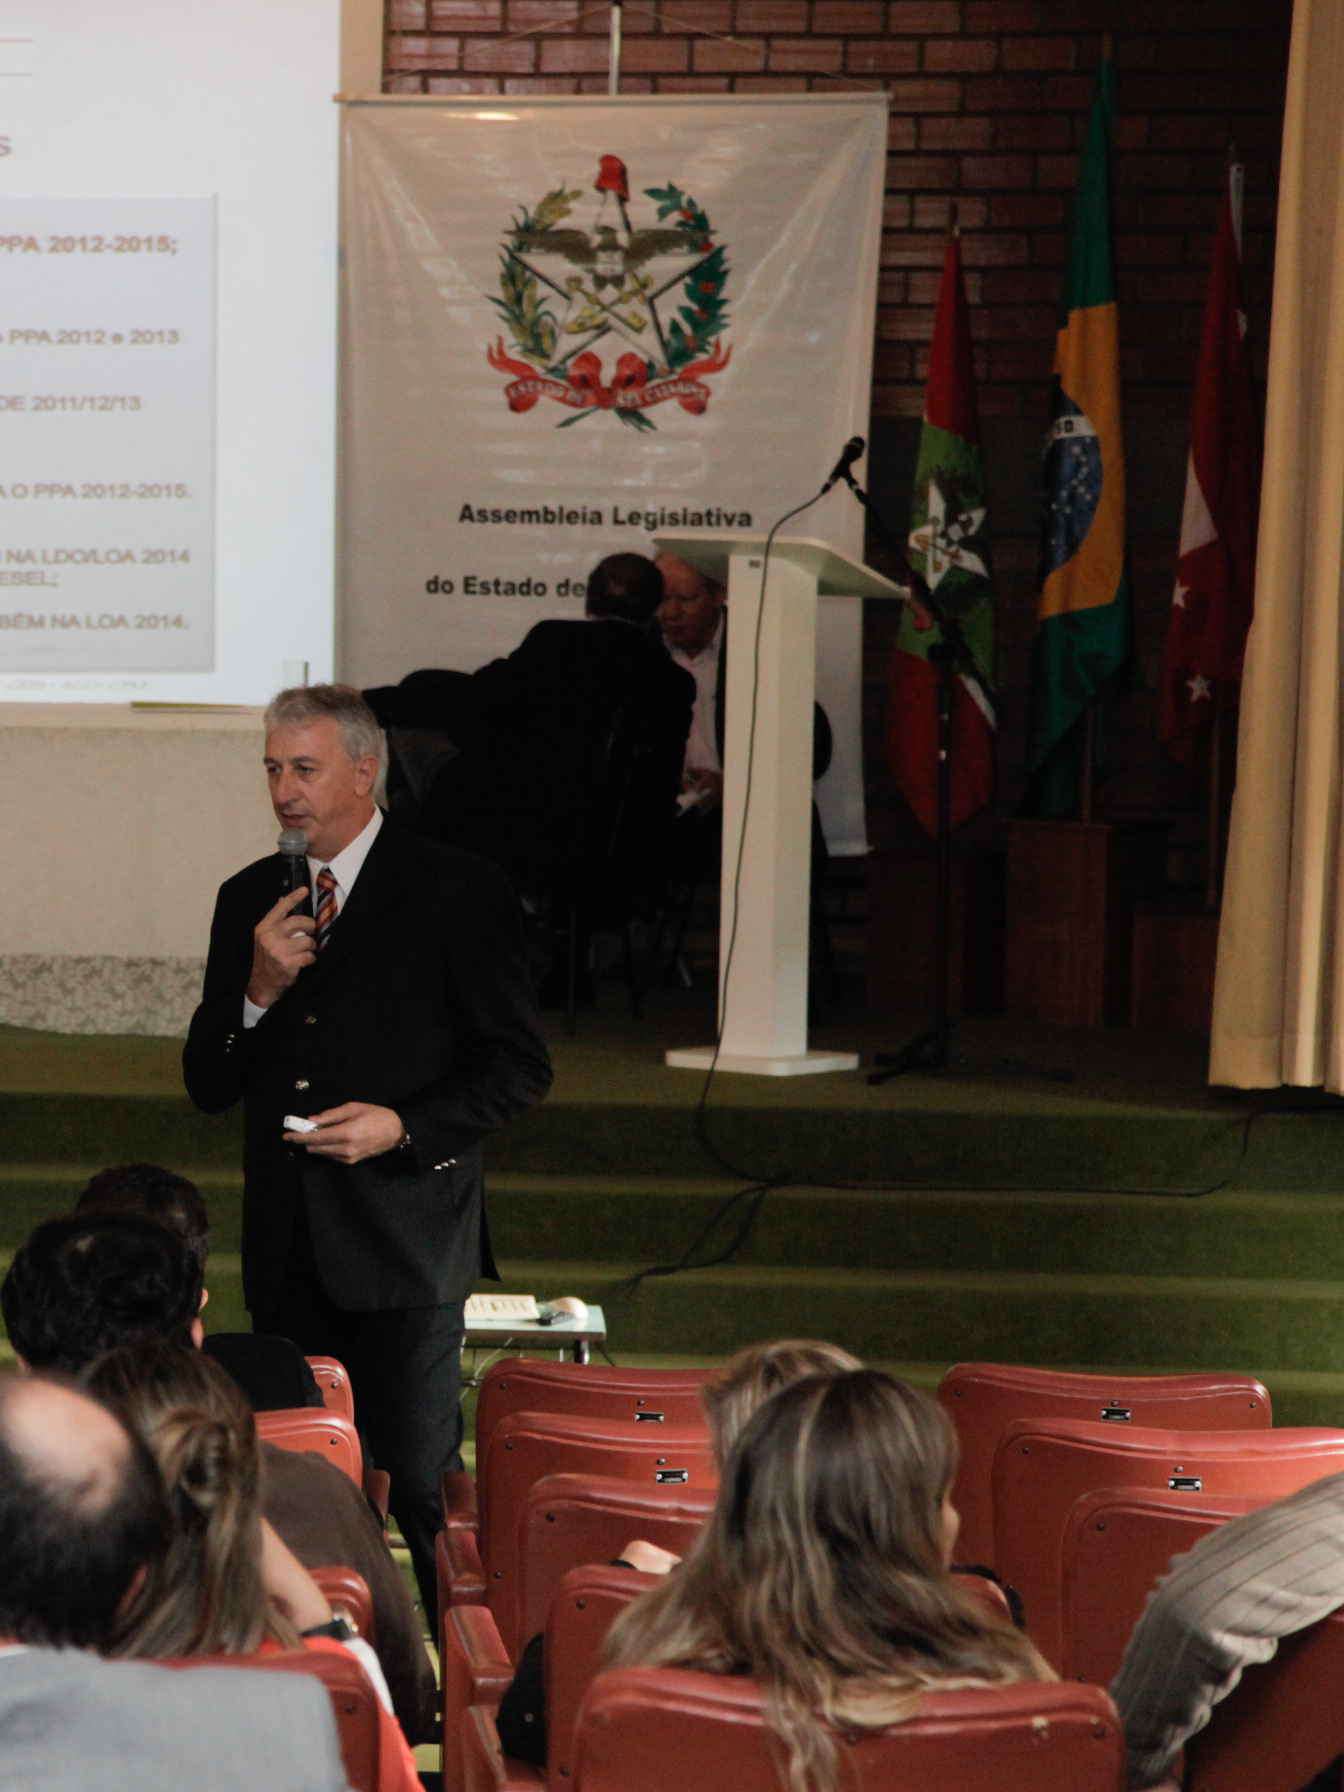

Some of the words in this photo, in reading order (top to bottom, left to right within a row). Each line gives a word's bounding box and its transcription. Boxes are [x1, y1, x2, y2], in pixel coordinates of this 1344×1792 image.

[48, 235, 177, 255] 2012-2015;
[9, 329, 52, 344] PPA
[57, 330, 106, 345] 2012
[111, 333, 124, 345] e
[130, 329, 179, 345] 2013
[32, 396, 141, 412] 2011/12/13
[11, 484, 29, 499] O
[34, 483, 77, 499] PPA
[459, 504, 603, 526] Assembleia
[613, 506, 752, 530] Legislativa
[6, 550, 37, 564] NA
[41, 549, 137, 565] LDO/LOA
[142, 549, 190, 565] 2014
[426, 575, 454, 595] do
[463, 576, 547, 597] Estado
[557, 578, 587, 598] de
[50, 615, 81, 630] NA
[85, 615, 129, 630] LOA
